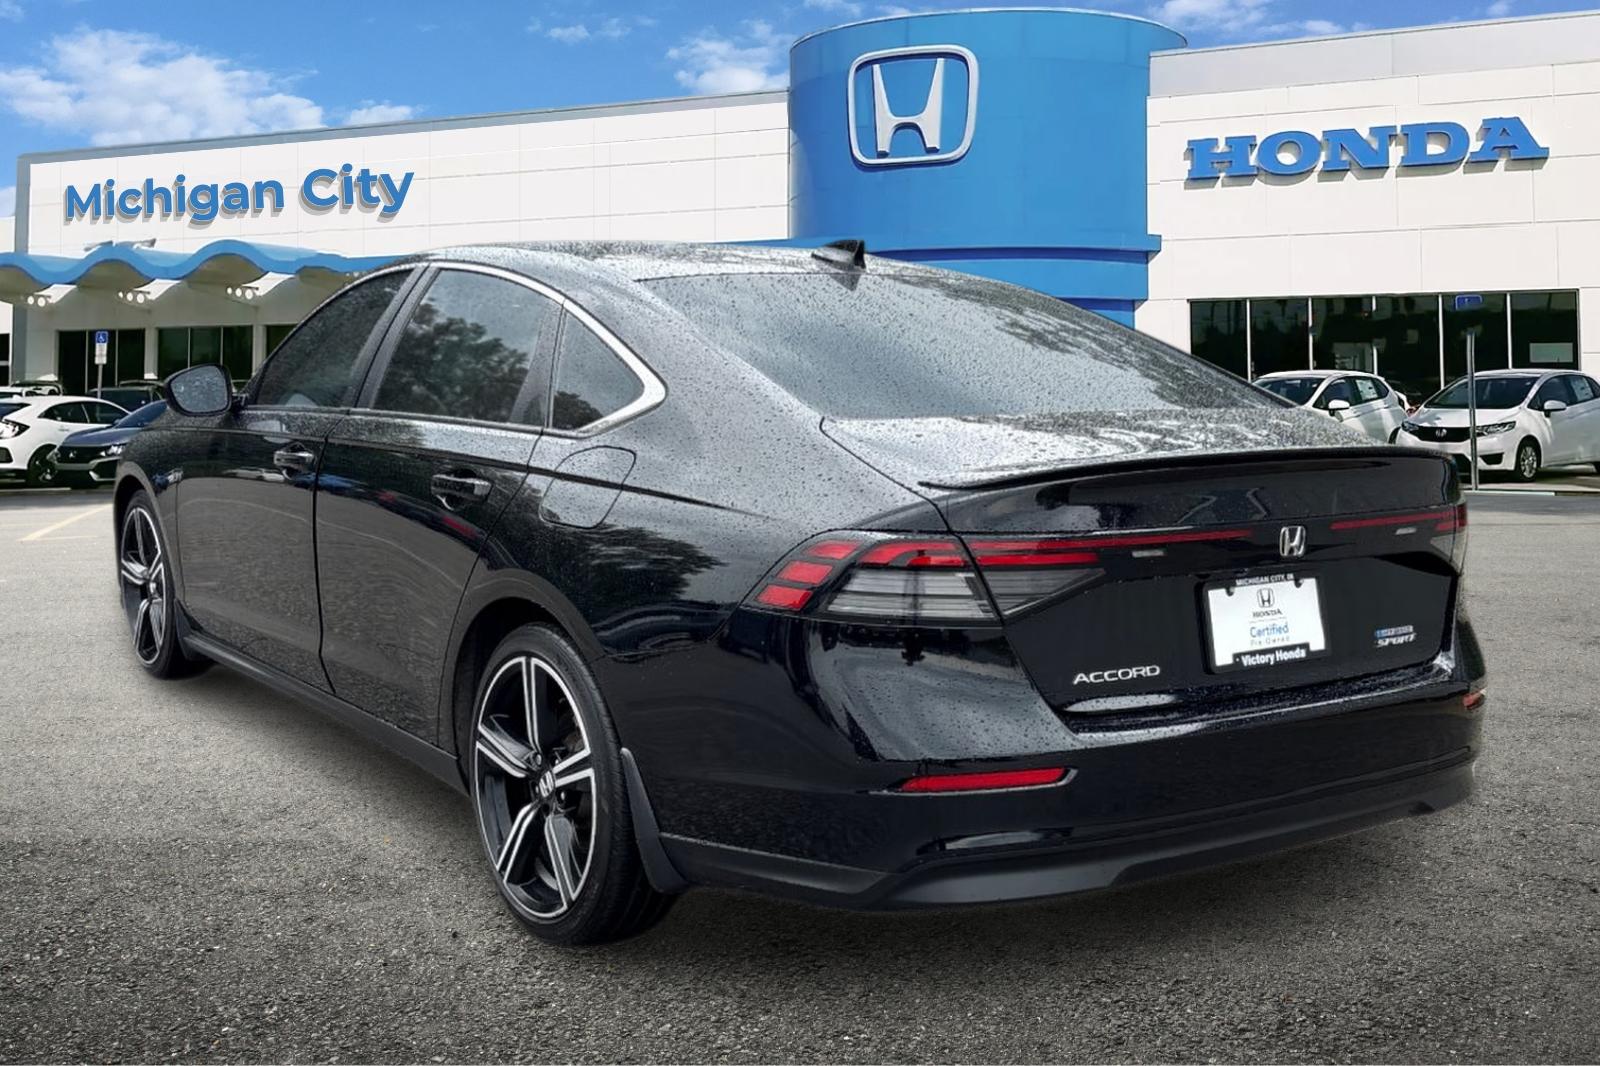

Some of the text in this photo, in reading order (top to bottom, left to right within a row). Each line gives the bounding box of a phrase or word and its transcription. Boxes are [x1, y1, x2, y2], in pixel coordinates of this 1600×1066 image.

[1186, 116, 1550, 181] HONDA
[65, 163, 415, 223] Michigan City
[1249, 621, 1290, 638] Certified
[1375, 632, 1416, 648] SPORT
[1241, 647, 1307, 667] Victory Honda
[1073, 664, 1161, 685] ACCORD
